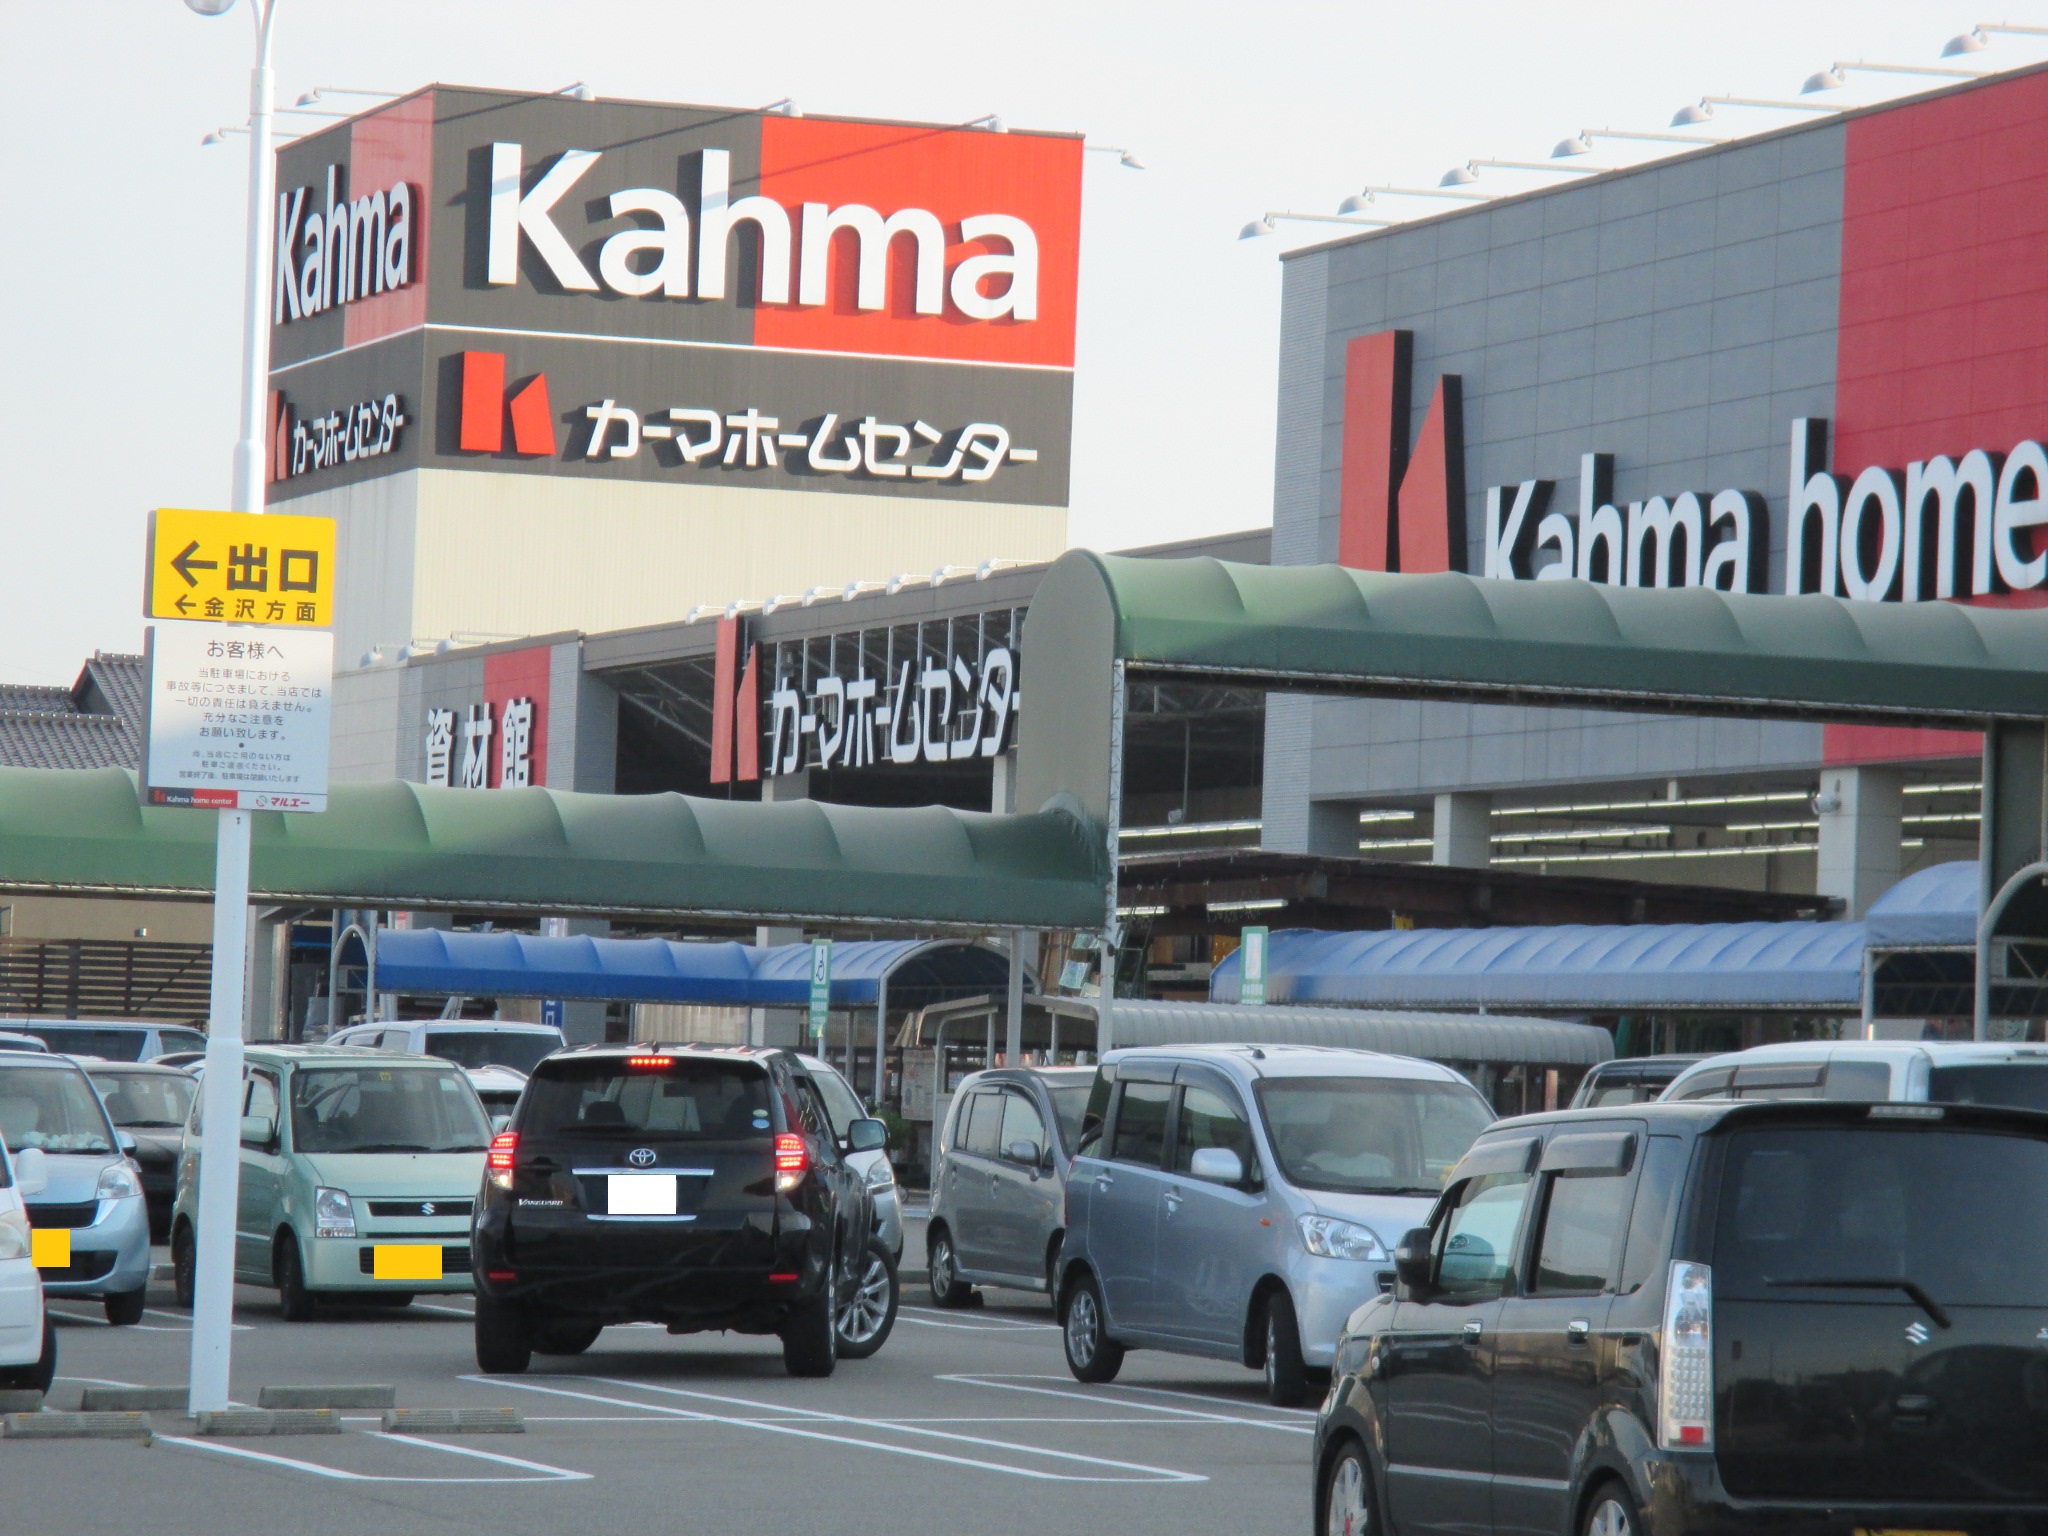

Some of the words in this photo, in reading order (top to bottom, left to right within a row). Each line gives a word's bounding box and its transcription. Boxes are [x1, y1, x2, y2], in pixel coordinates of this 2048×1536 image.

[488, 142, 1039, 321] Kahma
[275, 164, 413, 325] Kahma
[292, 393, 404, 476] カーマホームセンター
[586, 398, 1038, 482] カーマホームセンター
[1486, 453, 1750, 594] Kahma
[1788, 418, 2048, 602] home
[226, 543, 319, 593] 出口
[204, 596, 316, 622] 金沢方面
[206, 640, 285, 660] お客様へ
[199, 667, 291, 682] 当駐車場における
[166, 680, 322, 698] 事故等につきまして、当店では
[175, 696, 312, 713] 一切の責任は負えません。
[202, 712, 284, 726] 充分なご注意を
[199, 726, 286, 741] お願い致します。
[425, 697, 532, 788] 資材館
[191, 796, 210, 804] home
[271, 796, 311, 807] マルエー
